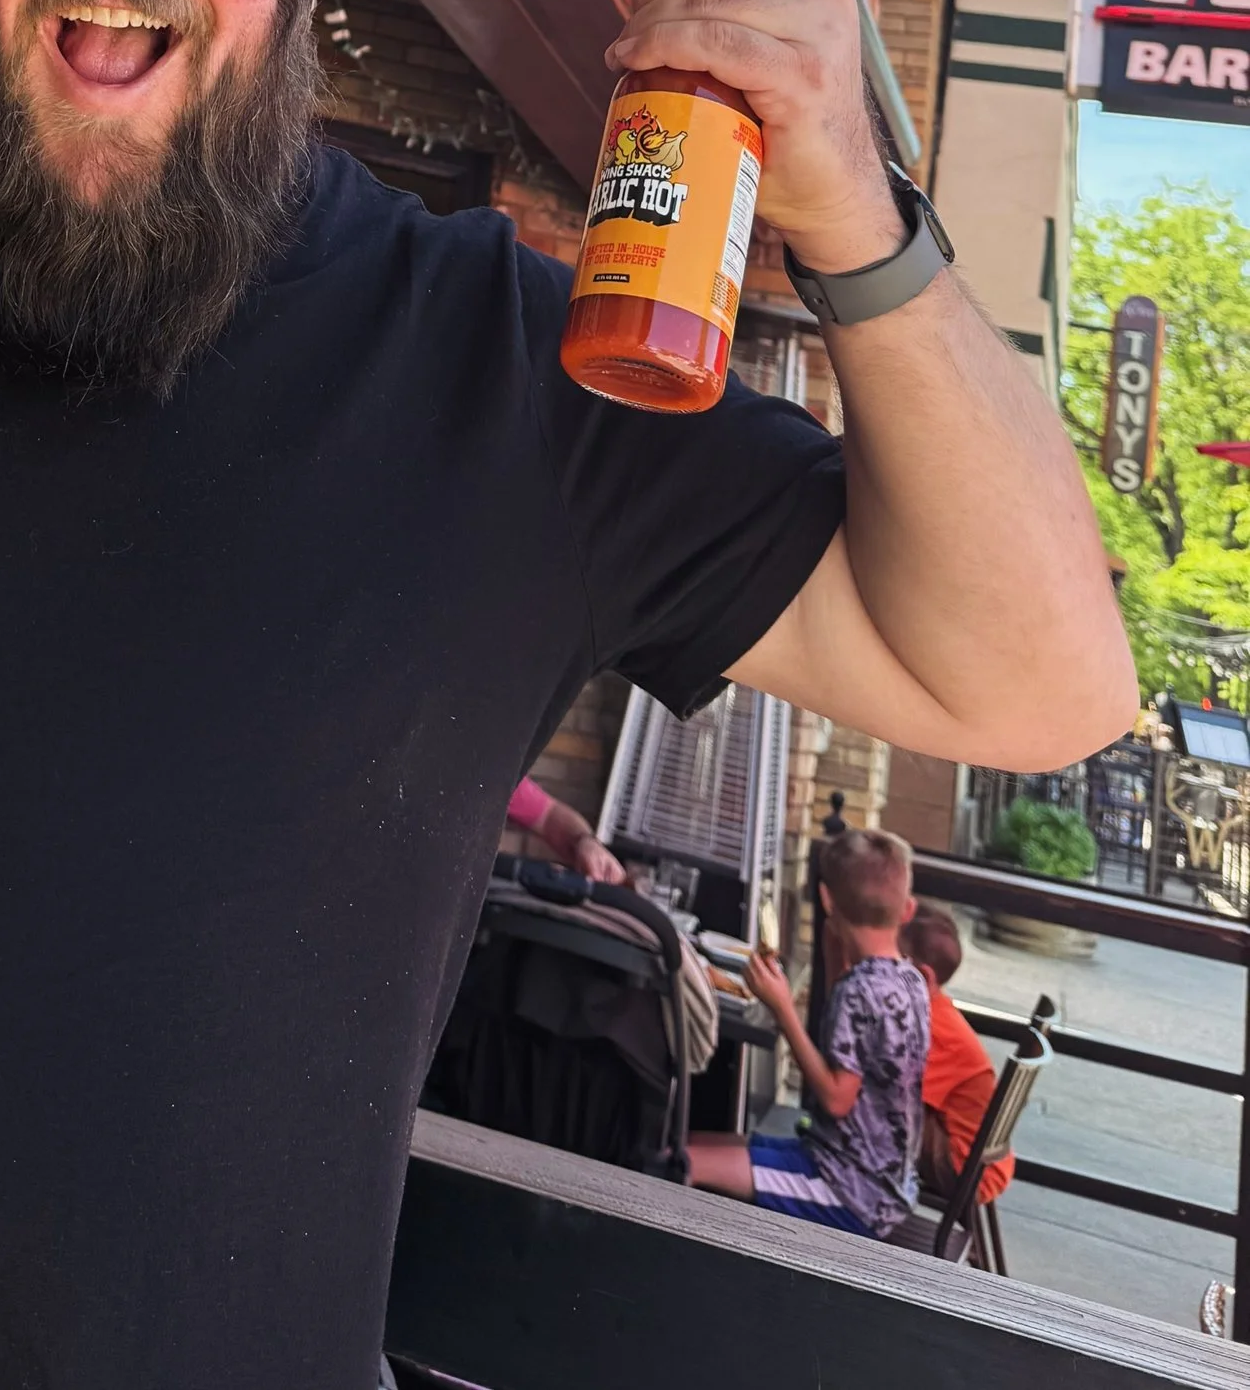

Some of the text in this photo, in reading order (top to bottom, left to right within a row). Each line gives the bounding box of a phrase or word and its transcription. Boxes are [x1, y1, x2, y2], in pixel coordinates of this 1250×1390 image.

[1125, 39, 1250, 91] BAR
[600, 162, 672, 183] WING SHACK
[590, 177, 689, 222] ARLIC HOT
[612, 253, 658, 268] EXPERTS
[616, 242, 667, 259] IN-HOUSE
[1110, 328, 1152, 492] TONYS
